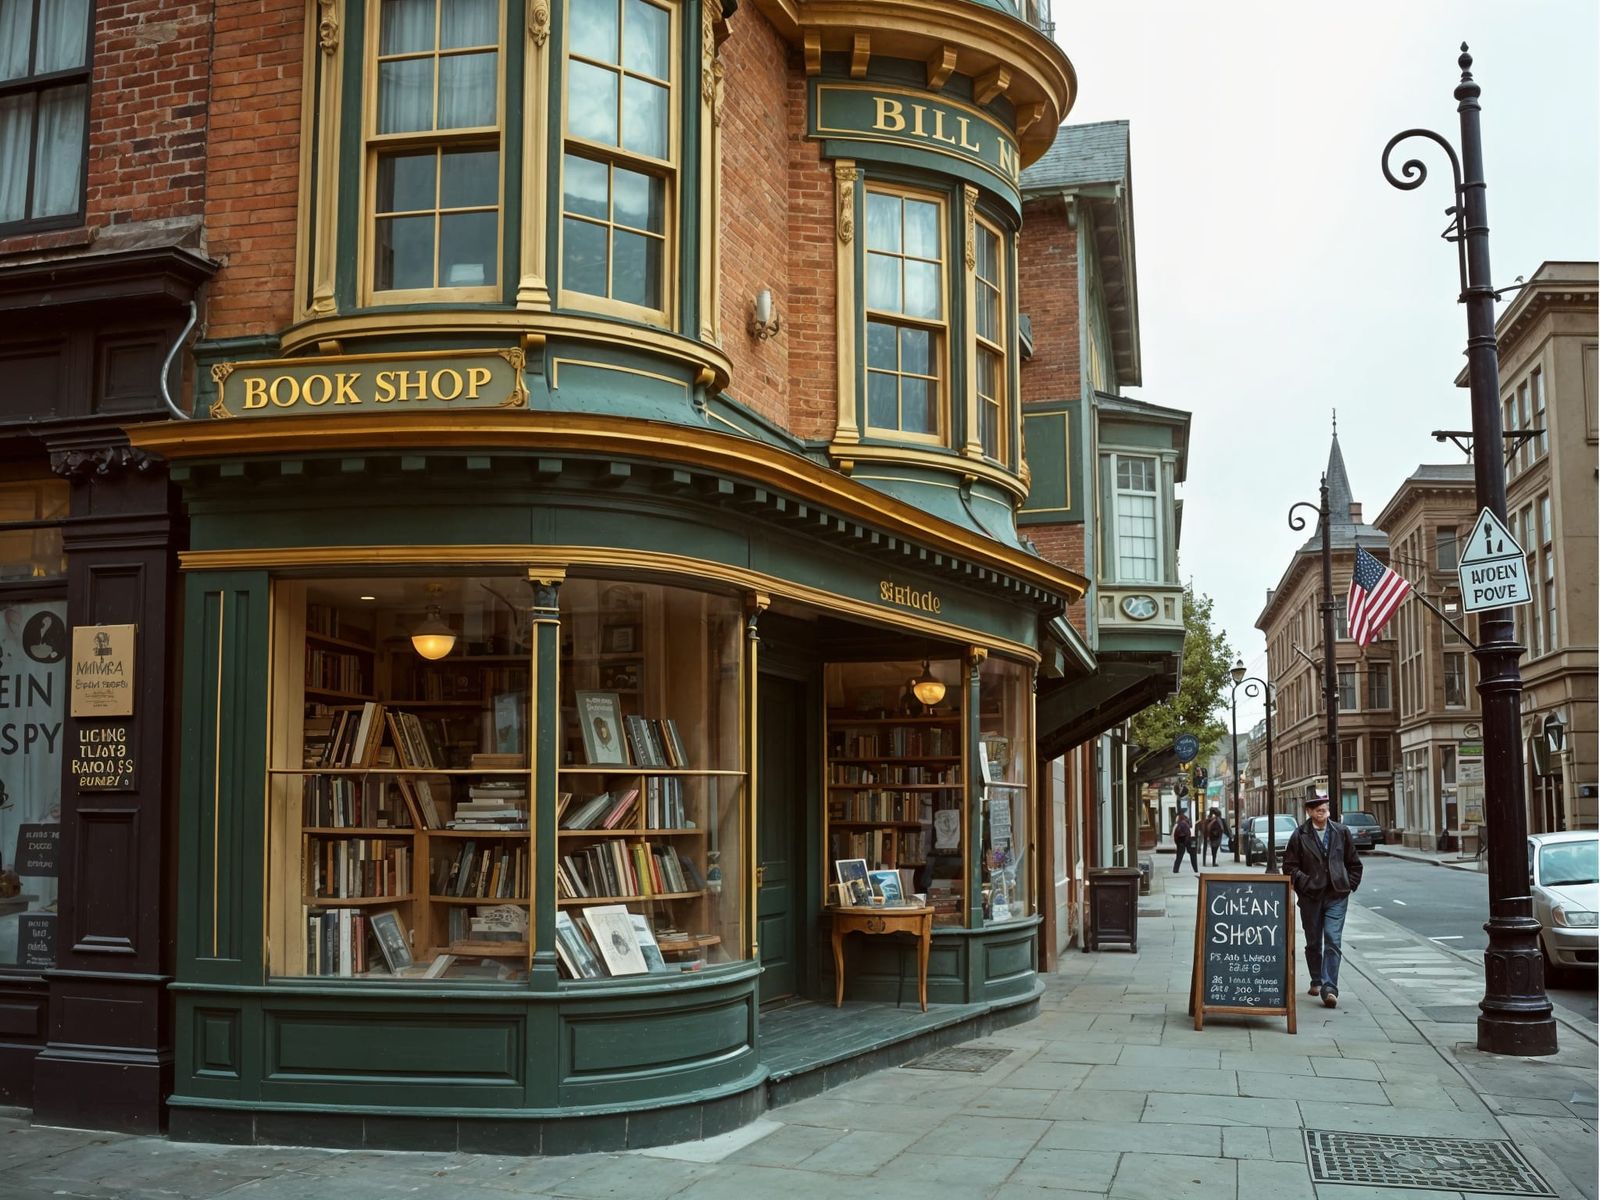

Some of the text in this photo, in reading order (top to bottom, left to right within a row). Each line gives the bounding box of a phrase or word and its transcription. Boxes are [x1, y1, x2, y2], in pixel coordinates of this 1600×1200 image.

[872, 97, 980, 153] BILL
[242, 367, 492, 409] BOOK SHOP
[1, 722, 62, 755] SPY
